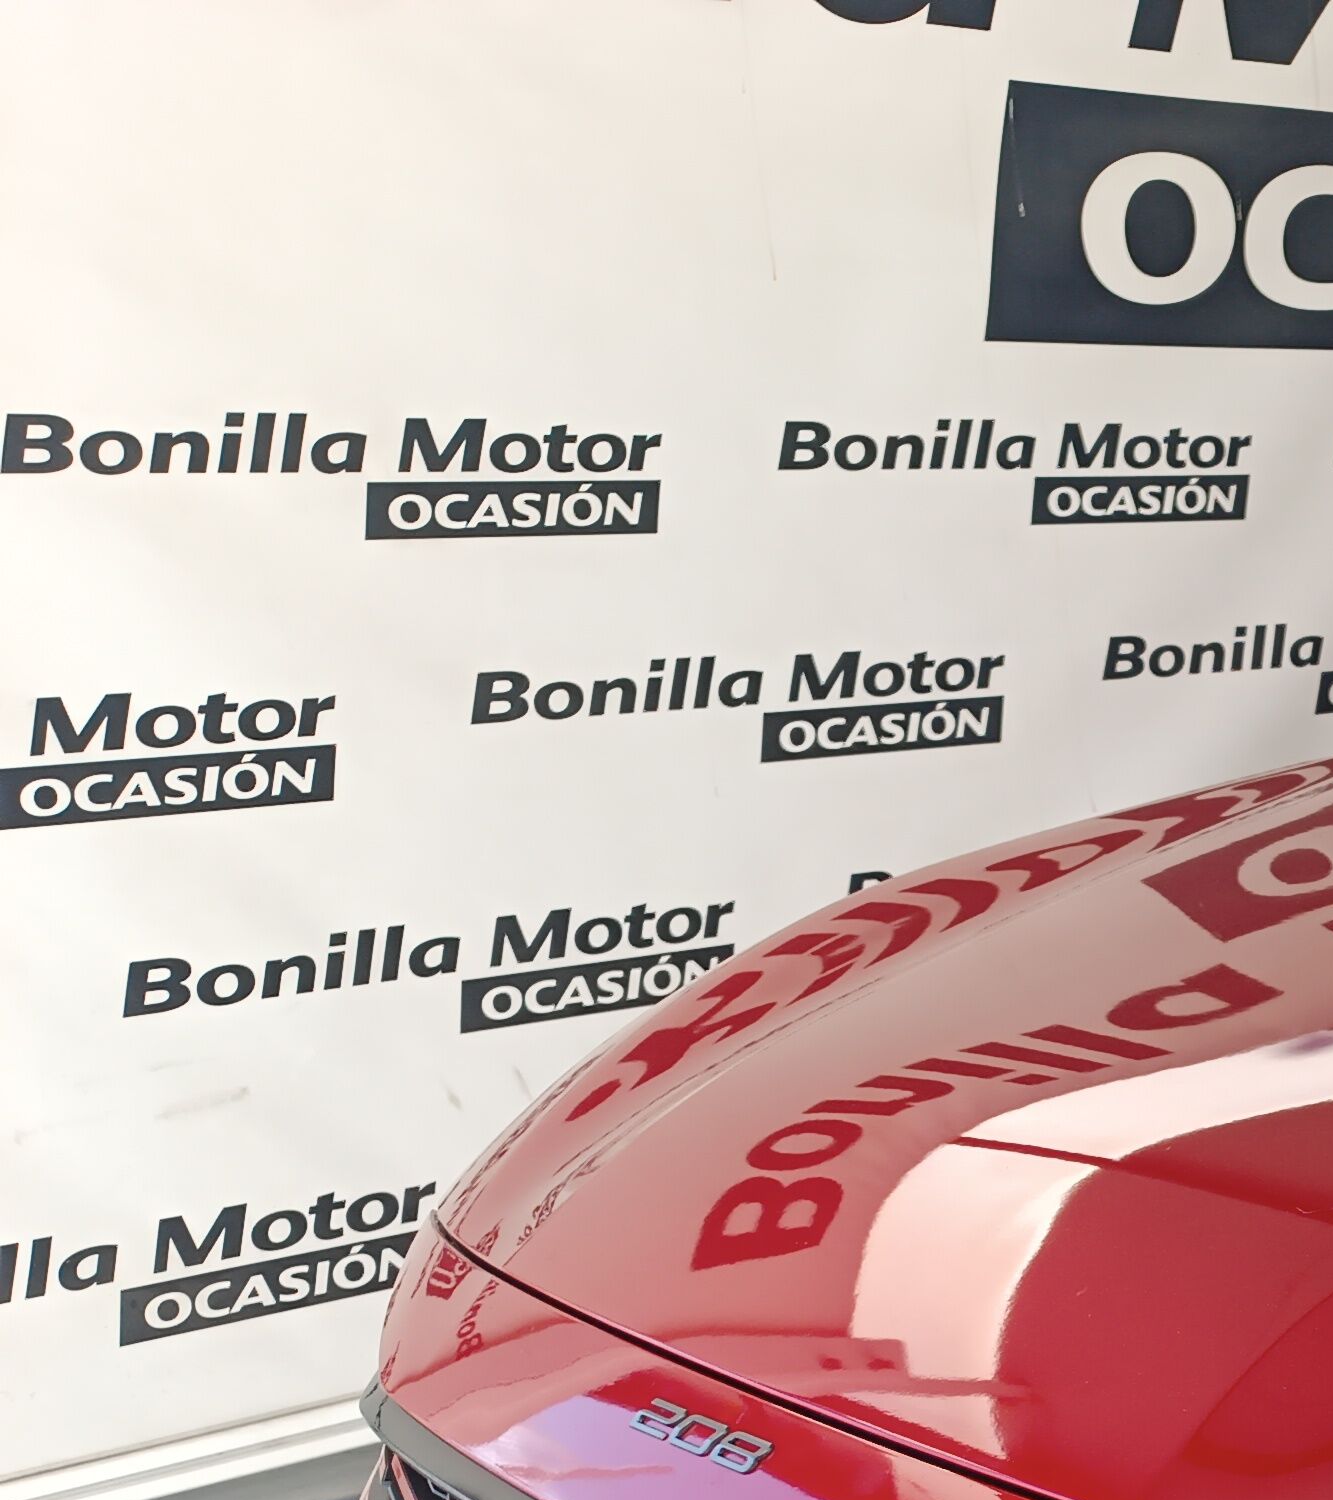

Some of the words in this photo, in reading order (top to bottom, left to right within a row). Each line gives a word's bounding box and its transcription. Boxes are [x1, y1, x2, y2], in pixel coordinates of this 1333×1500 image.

[1, 413, 367, 475] Bonilla
[398, 418, 662, 473] Motor
[777, 419, 1037, 472] Bonilla
[1057, 423, 1252, 468] Motor
[387, 484, 644, 531] OCASIÓN
[1047, 478, 1237, 517] OCASIÓN
[1102, 624, 1323, 681] Bonilla
[471, 656, 763, 725] Bonilla
[789, 649, 1004, 702] Motor
[29, 690, 336, 756] Motor
[778, 702, 990, 752] OCASIÓN
[20, 756, 316, 817] OCASIÓN
[123, 925, 461, 1018] Bonilla
[489, 900, 735, 967] Motor
[153, 1181, 437, 1274] Motor
[629, 1397, 776, 1475] 208
